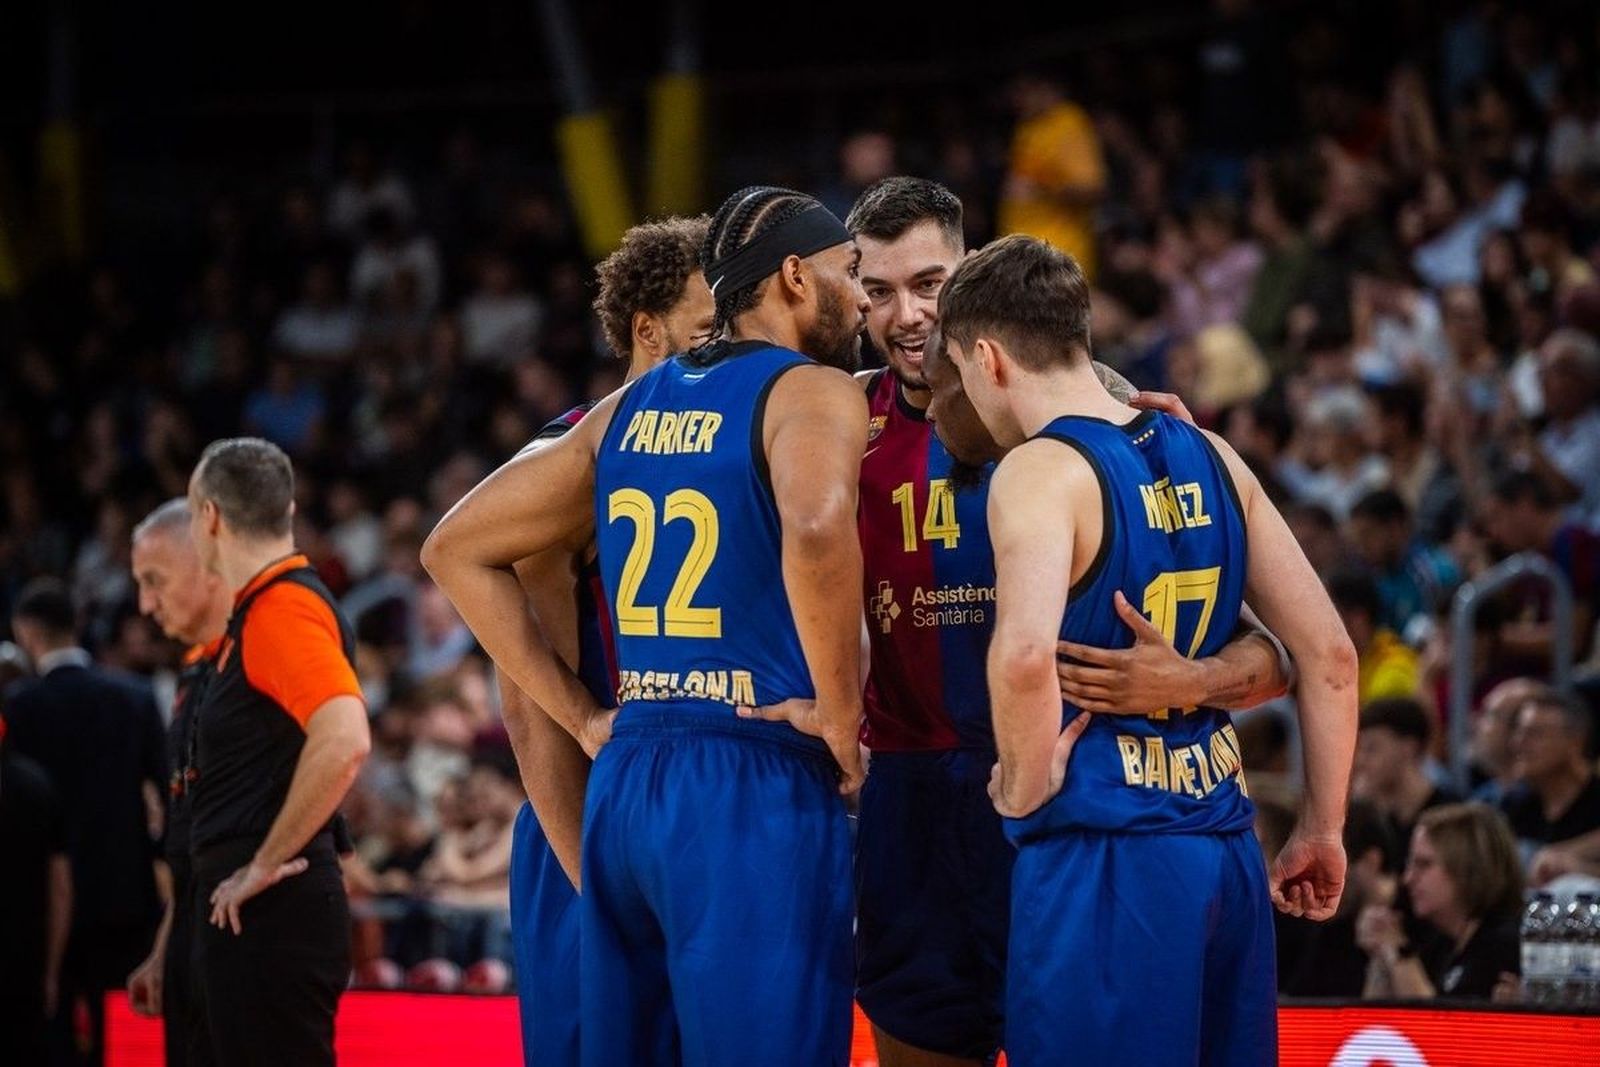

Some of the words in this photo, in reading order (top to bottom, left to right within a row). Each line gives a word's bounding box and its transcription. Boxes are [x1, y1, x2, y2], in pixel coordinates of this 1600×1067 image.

[618, 409, 723, 455] PARKER
[892, 479, 960, 552] 14
[1138, 475, 1213, 534] NÑEZ
[608, 487, 722, 639] 22
[911, 582, 997, 606] Assistènc
[912, 604, 985, 628] Sanitària
[1143, 566, 1222, 720] 17
